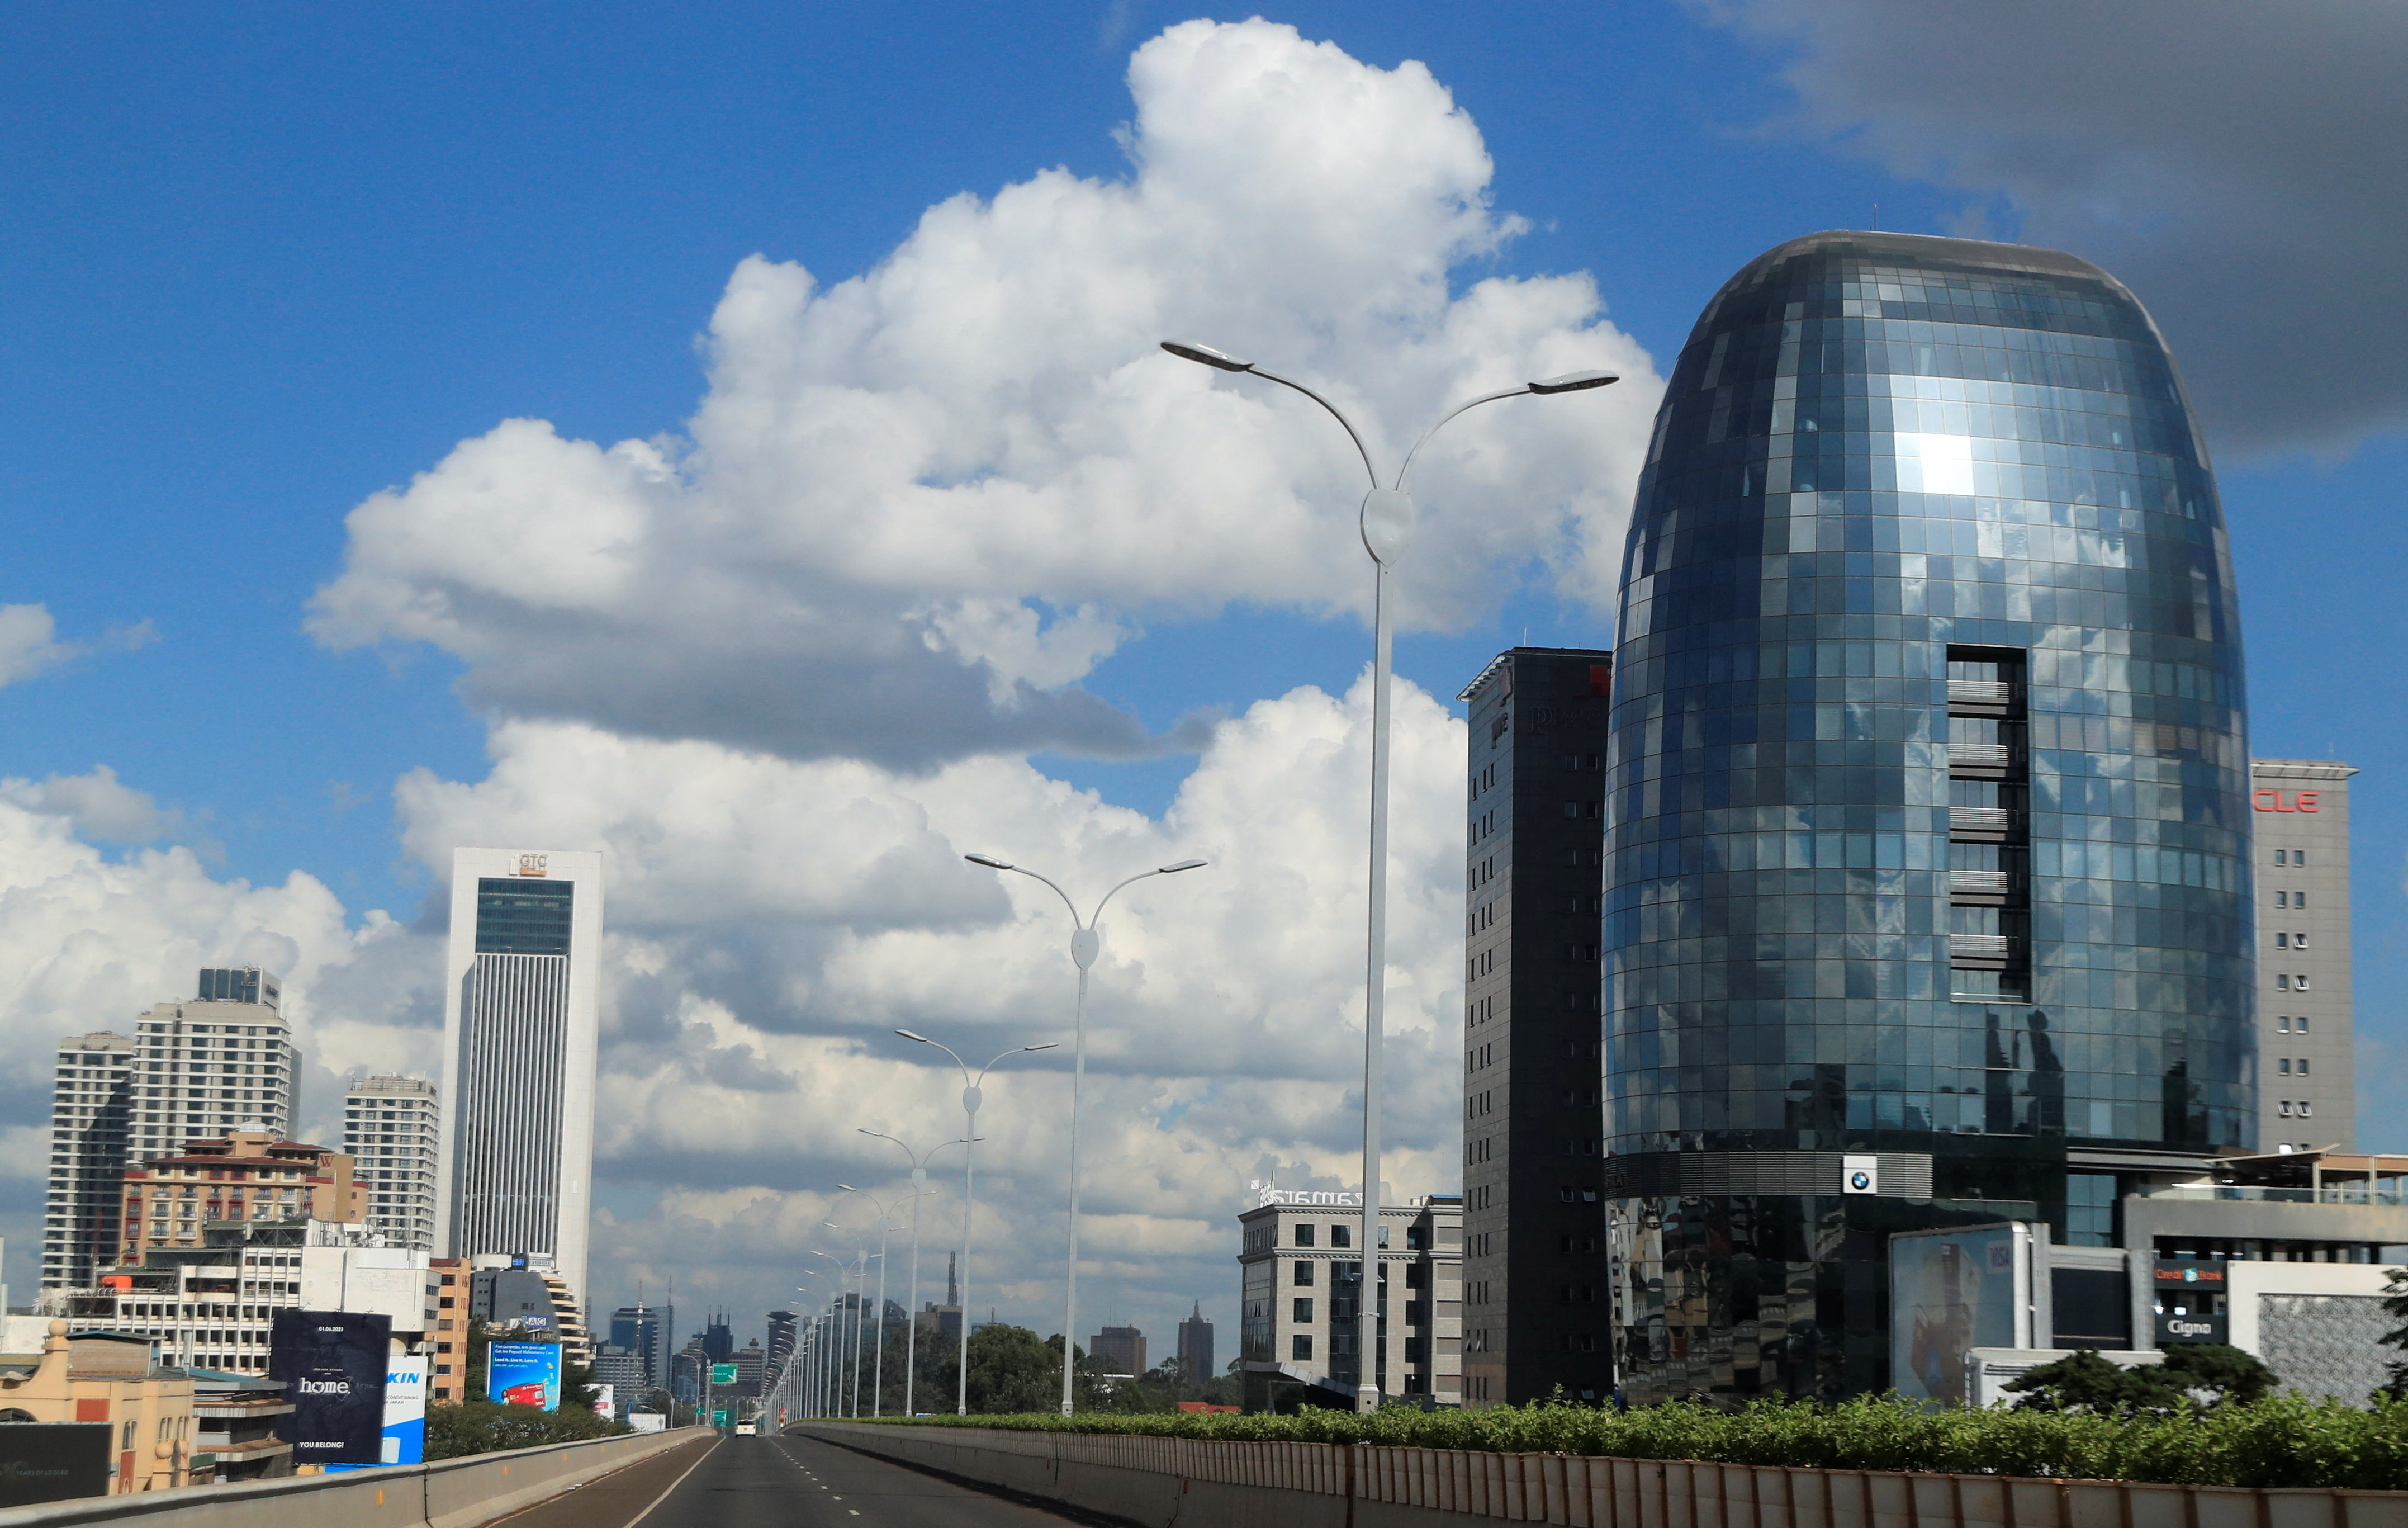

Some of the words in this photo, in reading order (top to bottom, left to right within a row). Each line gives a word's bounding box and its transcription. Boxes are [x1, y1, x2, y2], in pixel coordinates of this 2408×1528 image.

[2252, 790, 2320, 812] CLE
[2197, 1270, 2224, 1280] Bank
[2167, 1319, 2212, 1337] Cigna
[386, 1373, 420, 1383] KIN
